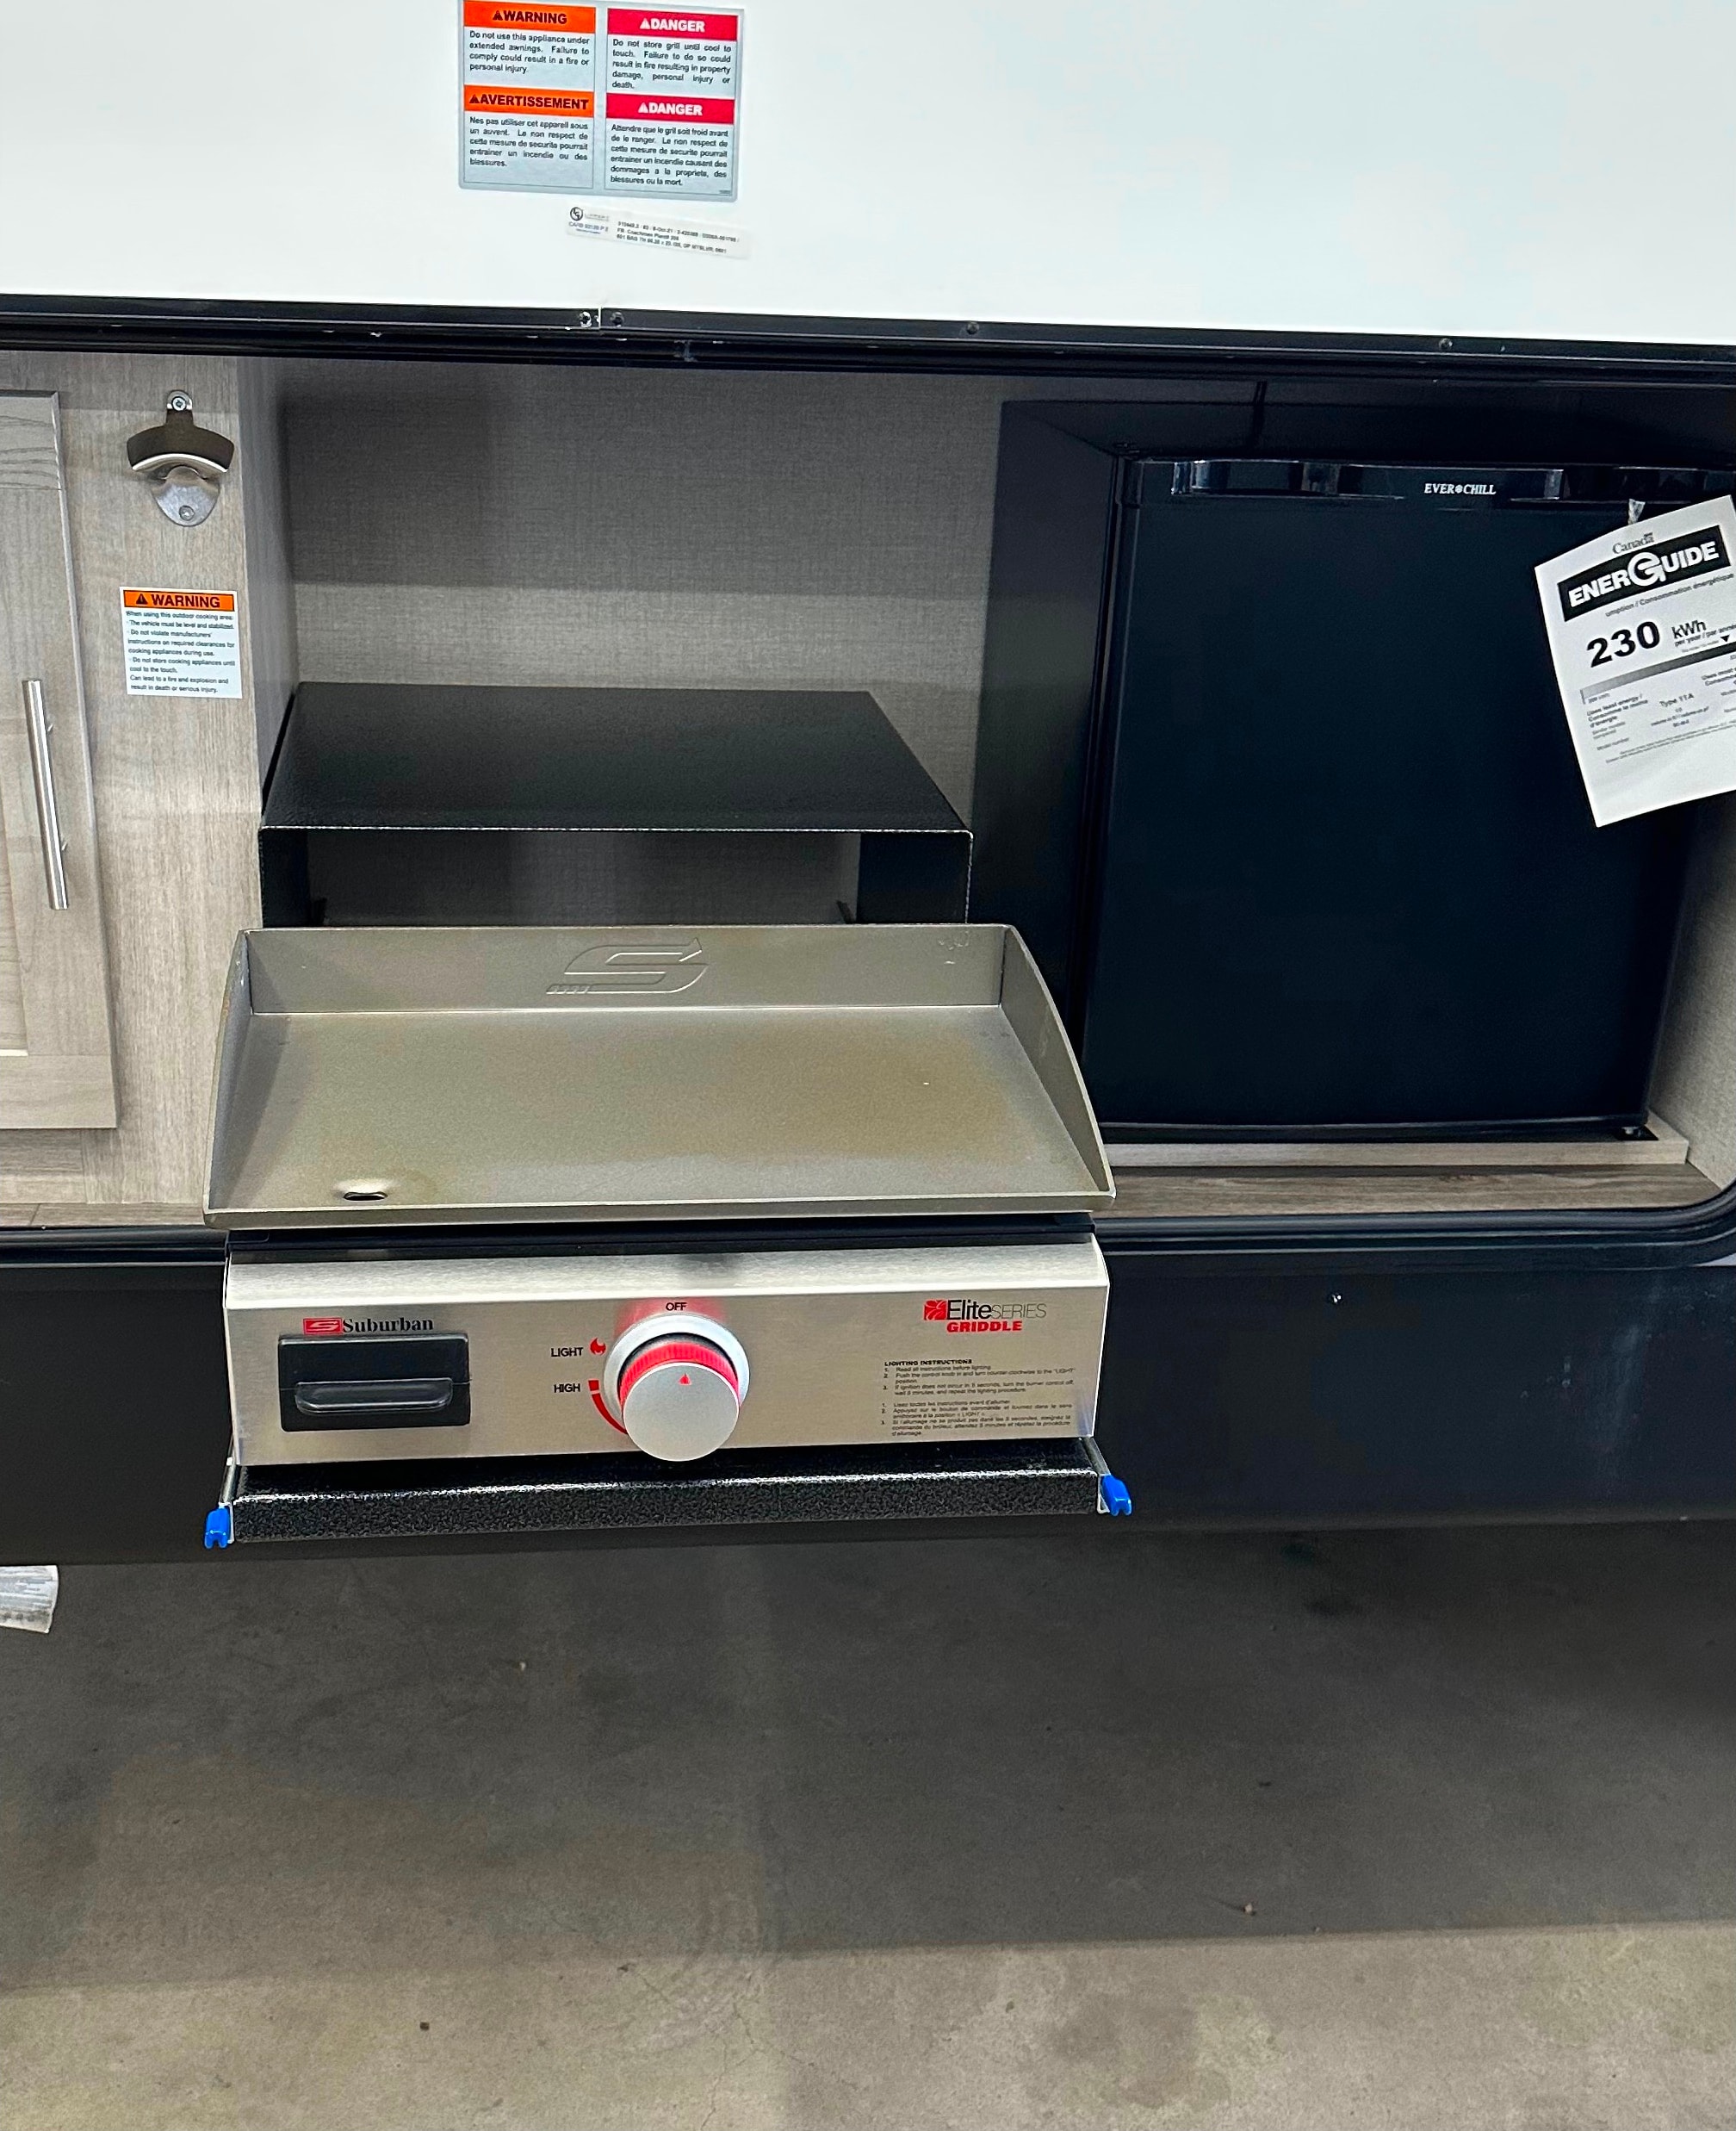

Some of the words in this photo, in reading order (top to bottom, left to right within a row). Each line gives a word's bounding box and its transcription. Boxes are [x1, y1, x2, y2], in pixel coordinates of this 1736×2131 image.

[504, 10, 567, 24] WARNING
[651, 18, 705, 32] DANGER
[509, 45, 542, 53] awnings.
[658, 63, 689, 72] resulting
[700, 65, 731, 74] property
[612, 71, 643, 79] damage,
[693, 75, 713, 84] injury
[480, 94, 589, 109] AVERTISSEMENT
[649, 103, 703, 115] DANGER
[549, 131, 575, 140] respect
[470, 158, 507, 167] blessures.
[611, 165, 649, 175] dommages
[1613, 534, 1654, 554] Canada
[1568, 541, 1720, 607] ENERGUIDE
[152, 594, 220, 607] WARNING
[1586, 621, 1659, 668] 230
[1671, 619, 1706, 639] kWh
[666, 1302, 687, 1311] OFF
[343, 1318, 433, 1333] Suburban
[947, 1321, 1022, 1333] GRIDDLE
[551, 1347, 584, 1357] LIGHT
[554, 1383, 580, 1393] HIGH
